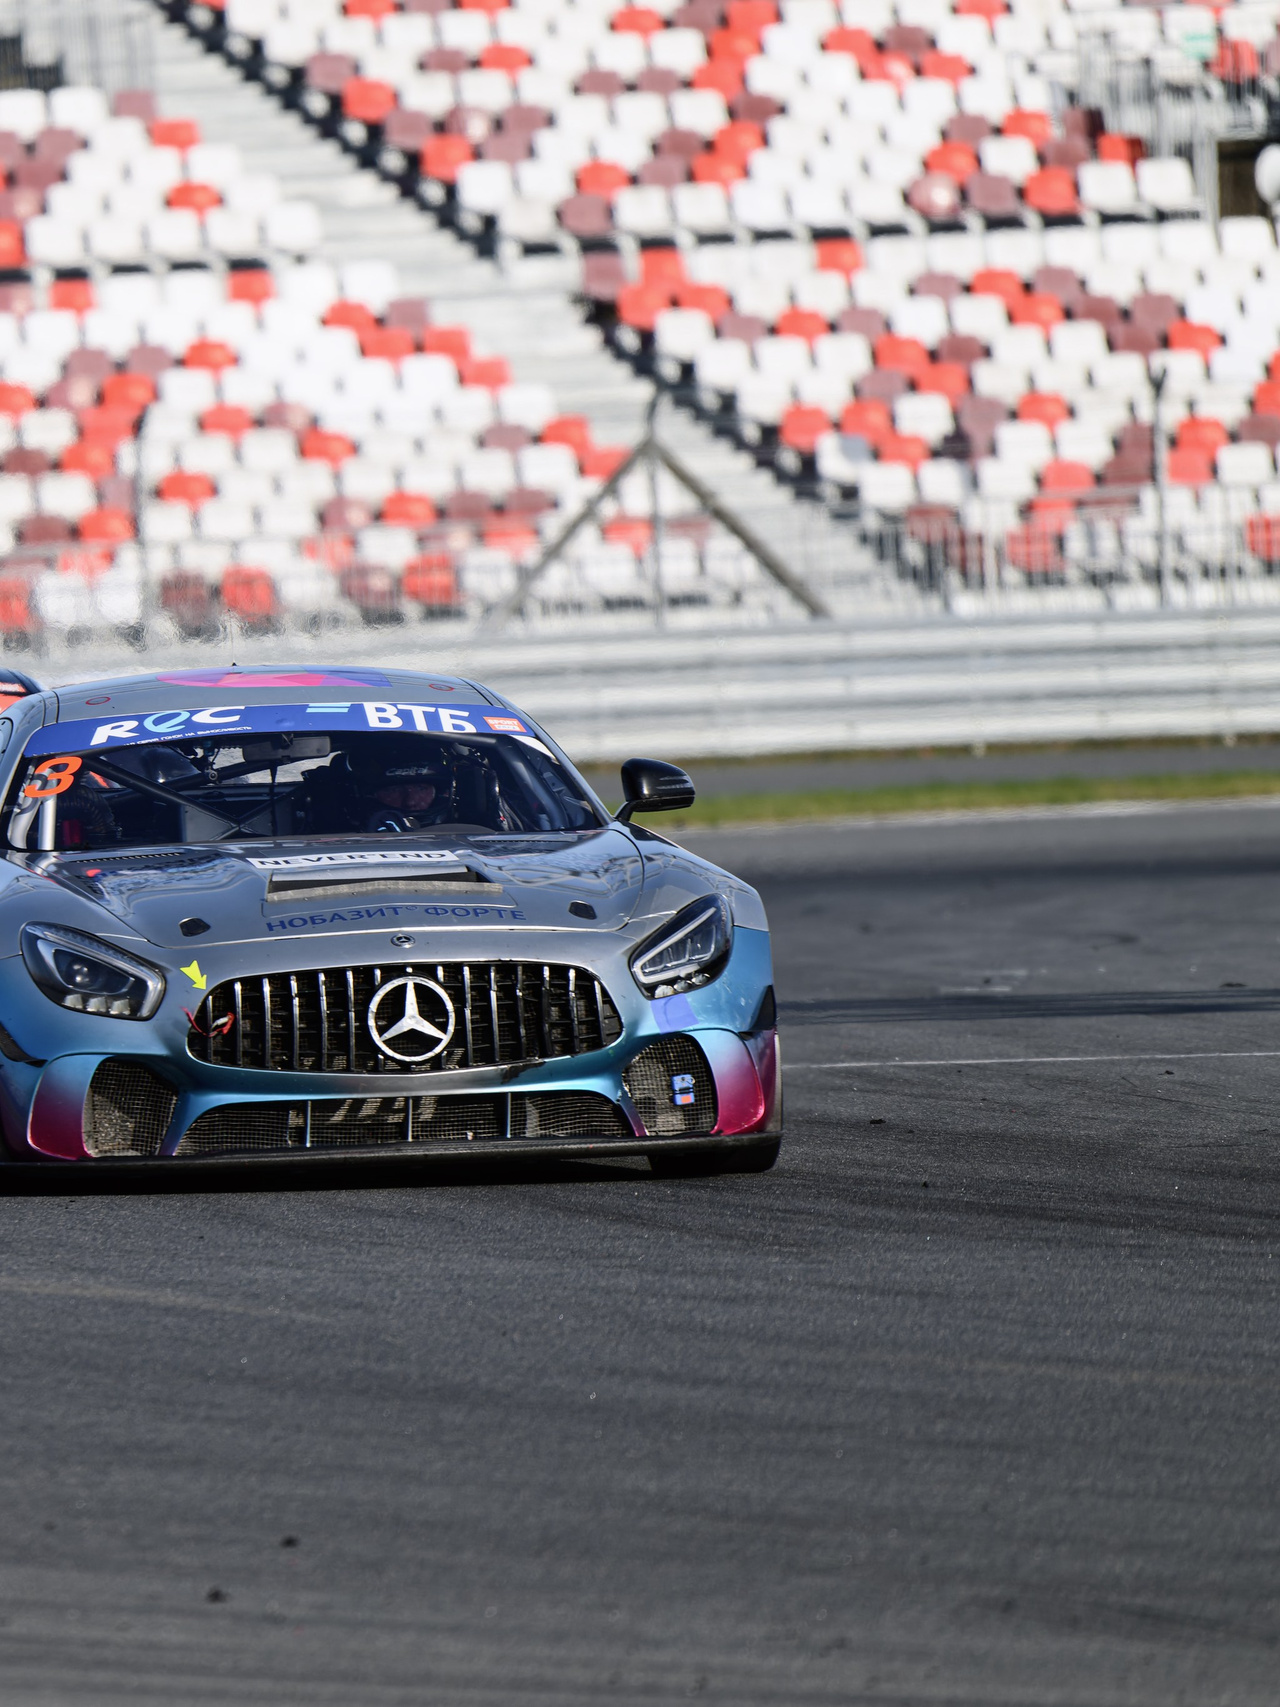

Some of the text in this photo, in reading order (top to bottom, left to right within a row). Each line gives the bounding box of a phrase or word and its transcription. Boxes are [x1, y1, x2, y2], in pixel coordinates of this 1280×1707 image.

[363, 702, 477, 733] ВТБ
[24, 756, 83, 798] 3
[424, 907, 527, 921] ФОРТЕ
